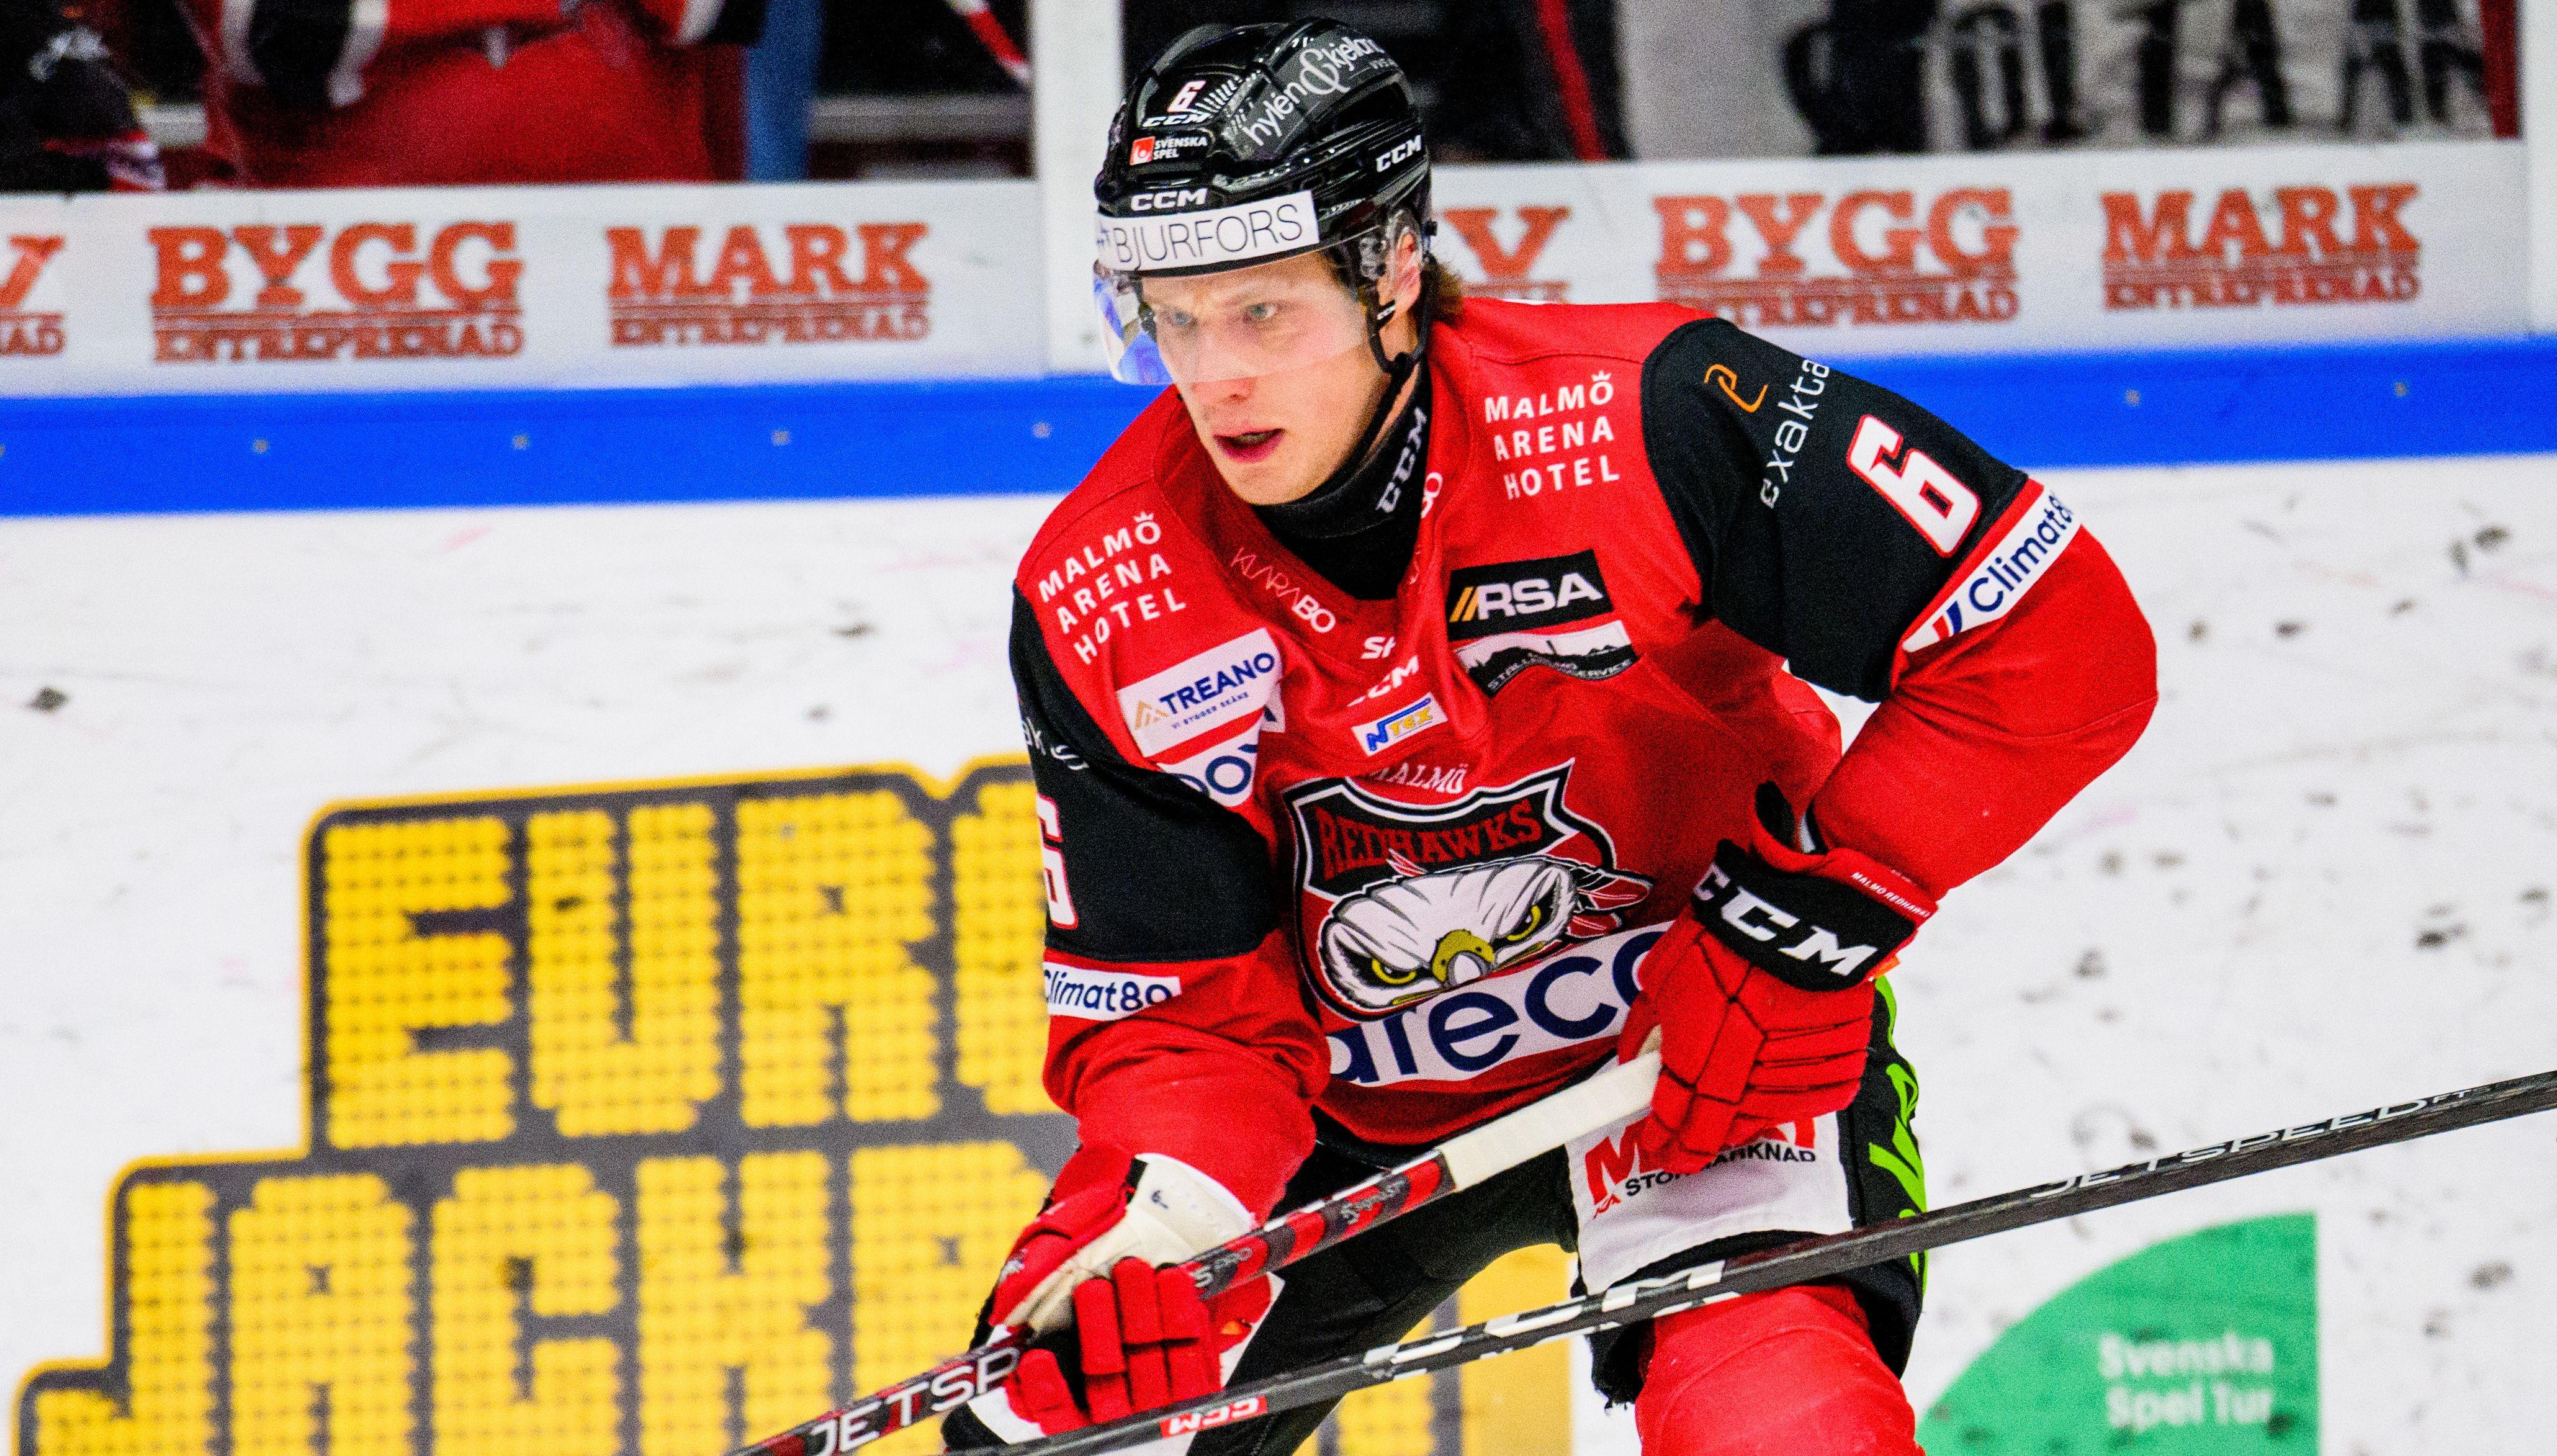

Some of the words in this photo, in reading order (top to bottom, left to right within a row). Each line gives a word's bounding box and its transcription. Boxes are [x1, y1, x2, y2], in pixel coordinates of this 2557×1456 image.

[1142, 111, 1210, 128] CCM
[1167, 80, 1206, 112] 6
[1153, 149, 1180, 160] SPEL
[1154, 136, 1208, 150] SVENSKA
[1375, 135, 1422, 173] CCM
[1130, 187, 1208, 212] CCM
[2100, 183, 2420, 263] MARK
[148, 221, 524, 310] BYGG
[605, 222, 930, 297] MARK
[1113, 204, 1302, 271] BJURFORS
[1652, 187, 2020, 282] BYGG
[1485, 371, 1614, 423] MALMÖ
[1494, 415, 1615, 461] ARENA
[1504, 455, 1619, 500] HOTEL
[1846, 413, 1982, 558] 6
[1038, 510, 1162, 603] MALMÖ
[1969, 490, 2074, 613] Climat8
[1056, 553, 1172, 634] ARENA
[1074, 588, 1186, 664] HOTEL
[1159, 652, 1275, 715] TREANO
[1347, 655, 1420, 708] CM
[1314, 798, 1544, 881] REDHAWKS
[1693, 861, 1879, 977] CCM
[2029, 1098, 2427, 1198] JETSPEED
[35, 1139, 1053, 1456] JACKP
[2098, 1329, 2275, 1380] Svenska
[809, 1346, 1020, 1456] JETSP
[1168, 1396, 1260, 1436] CCM
[2106, 1383, 2205, 1434] Spel
